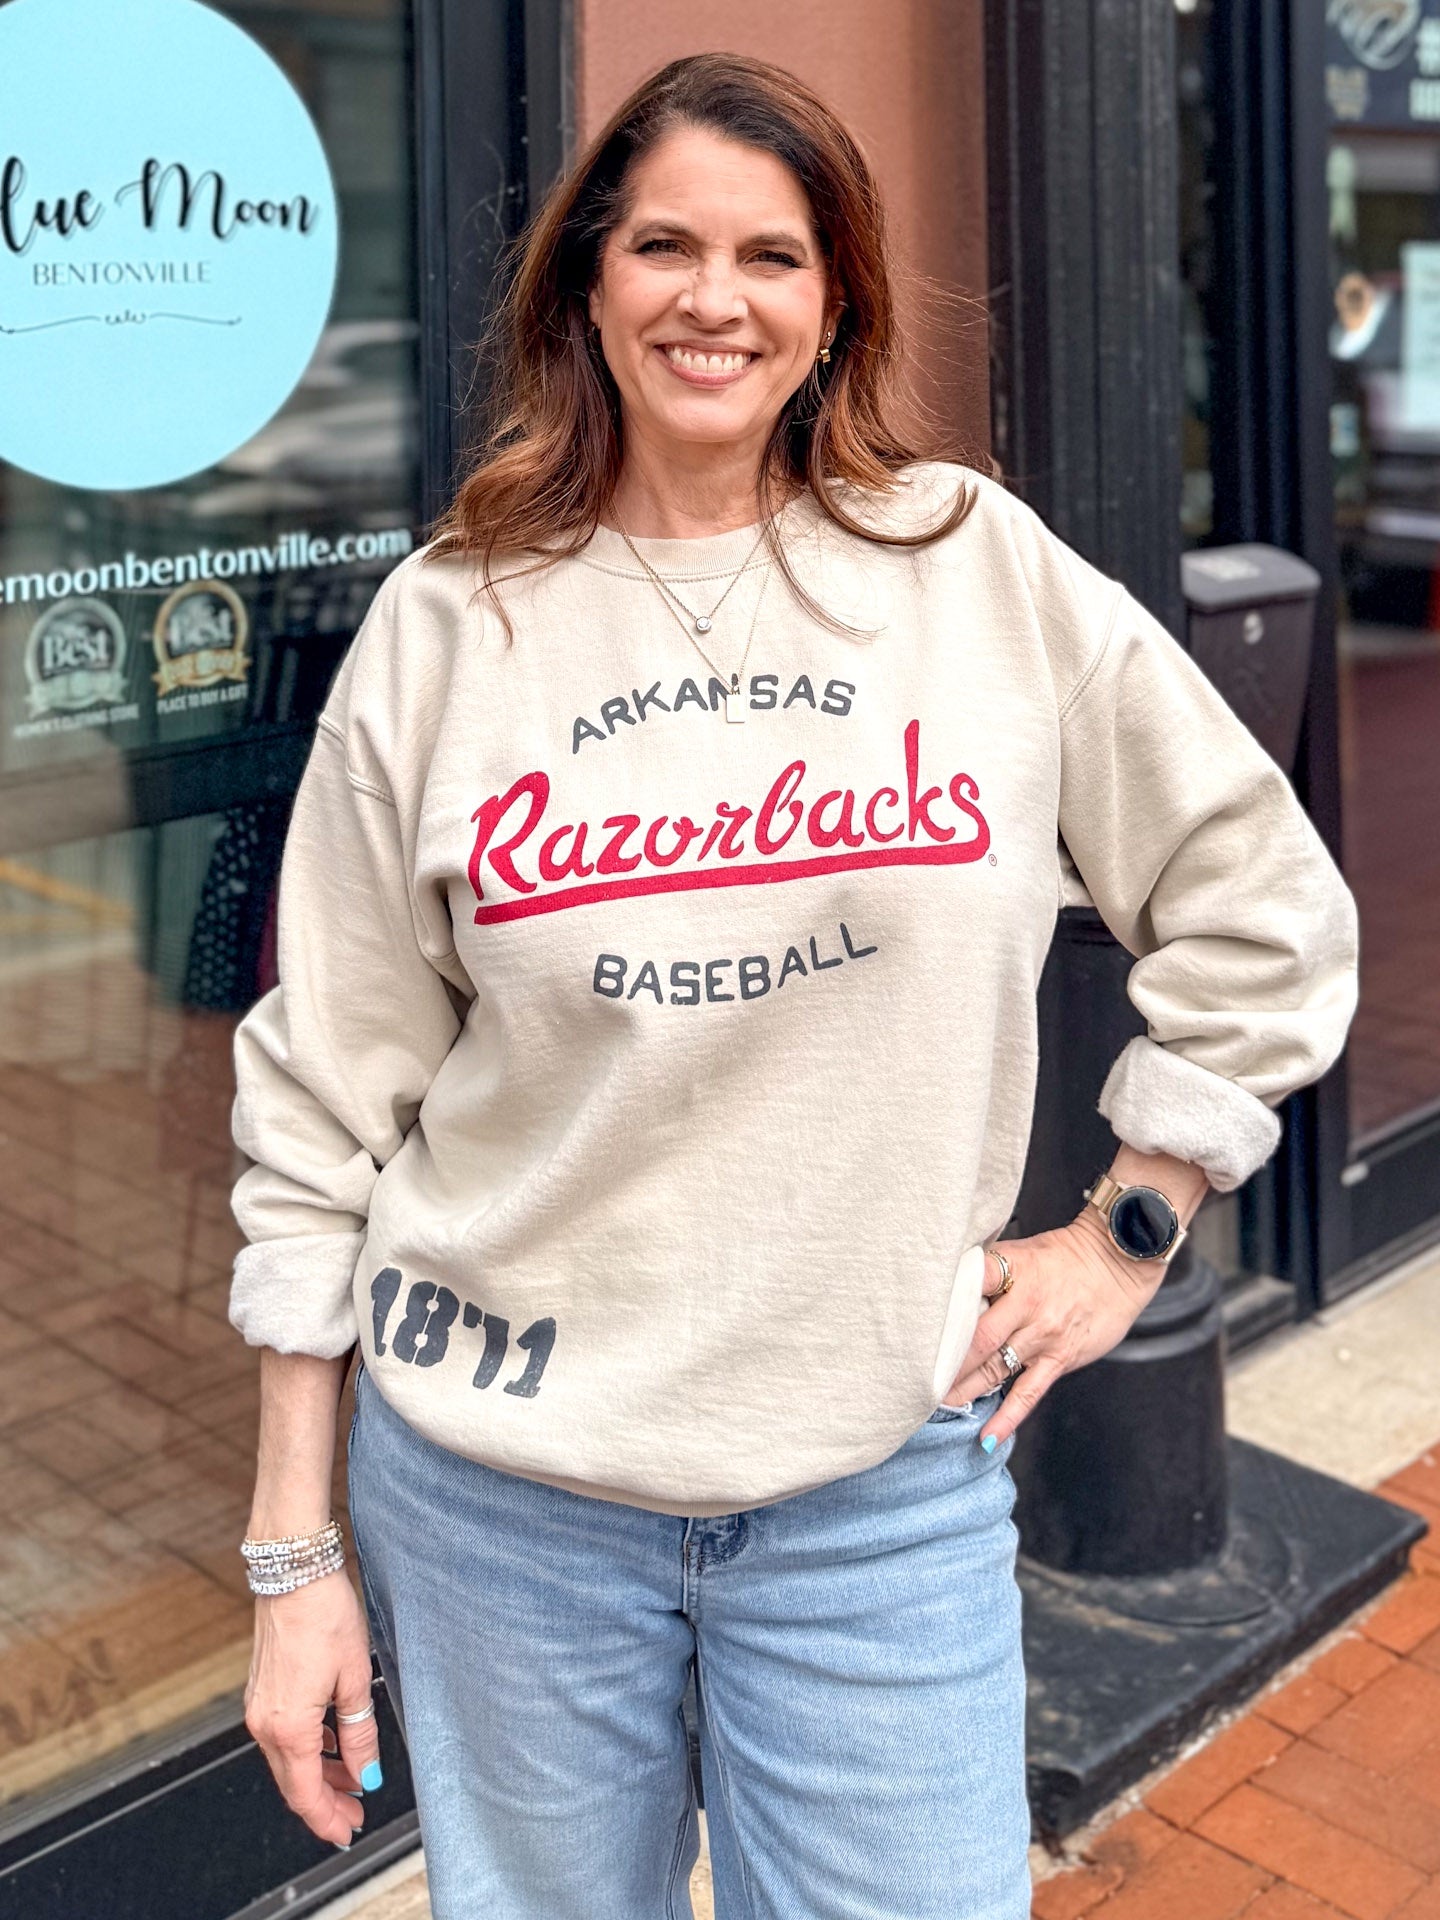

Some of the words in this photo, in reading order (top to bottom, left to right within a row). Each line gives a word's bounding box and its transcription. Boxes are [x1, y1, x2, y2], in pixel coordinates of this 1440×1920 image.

[0, 156, 101, 254] lue
[115, 158, 317, 240] Moon
[33, 261, 211, 286] BENTONVILLE
[0, 529, 412, 604] moonbentonville.com
[572, 673, 856, 755] ARKANSAS
[468, 719, 990, 905] Razorbacks
[594, 923, 878, 1005] BASEBALL
[371, 1267, 556, 1398] 1871
